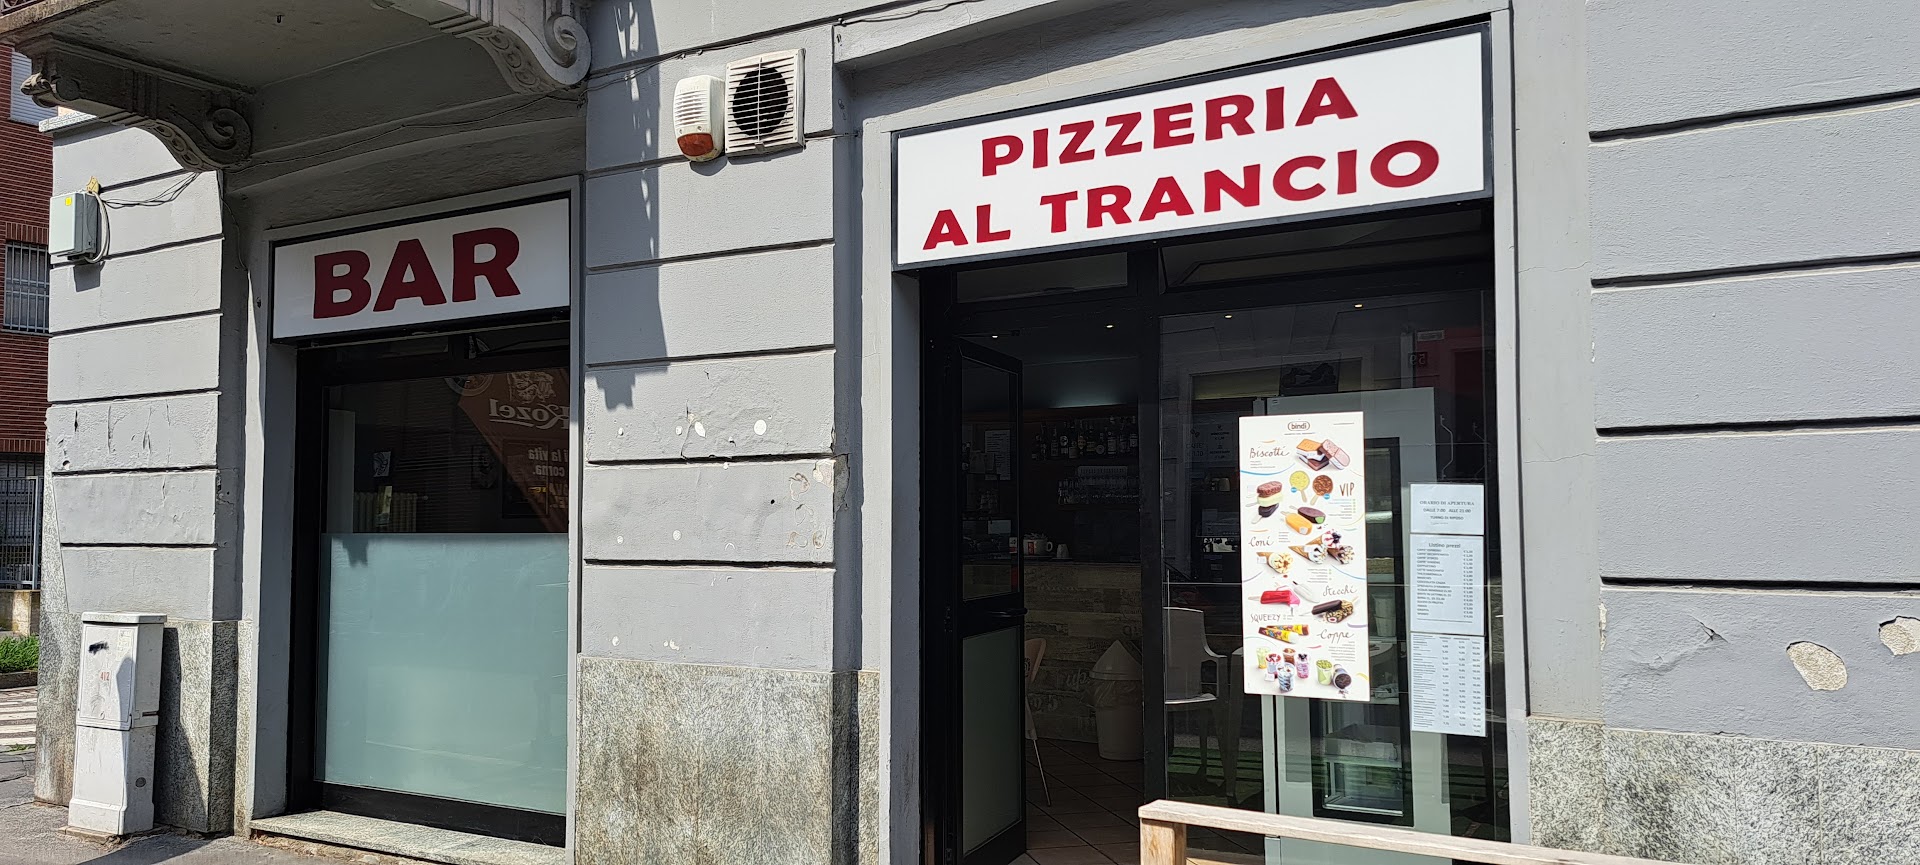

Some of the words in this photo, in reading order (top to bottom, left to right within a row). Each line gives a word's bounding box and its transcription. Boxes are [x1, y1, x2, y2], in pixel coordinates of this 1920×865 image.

[980, 77, 1358, 177] PIZZERIA
[922, 204, 1011, 250] AL
[1039, 140, 1439, 234] TRANCIO
[313, 227, 520, 319] BAR
[1291, 422, 1307, 430] bindi
[1249, 446, 1290, 459] Biscotti
[1339, 482, 1355, 497] VIP
[1248, 536, 1274, 547] Coni
[1323, 584, 1357, 597] Stecchi
[1250, 613, 1280, 623] SQUEEZY
[1318, 629, 1354, 643] Coppe
